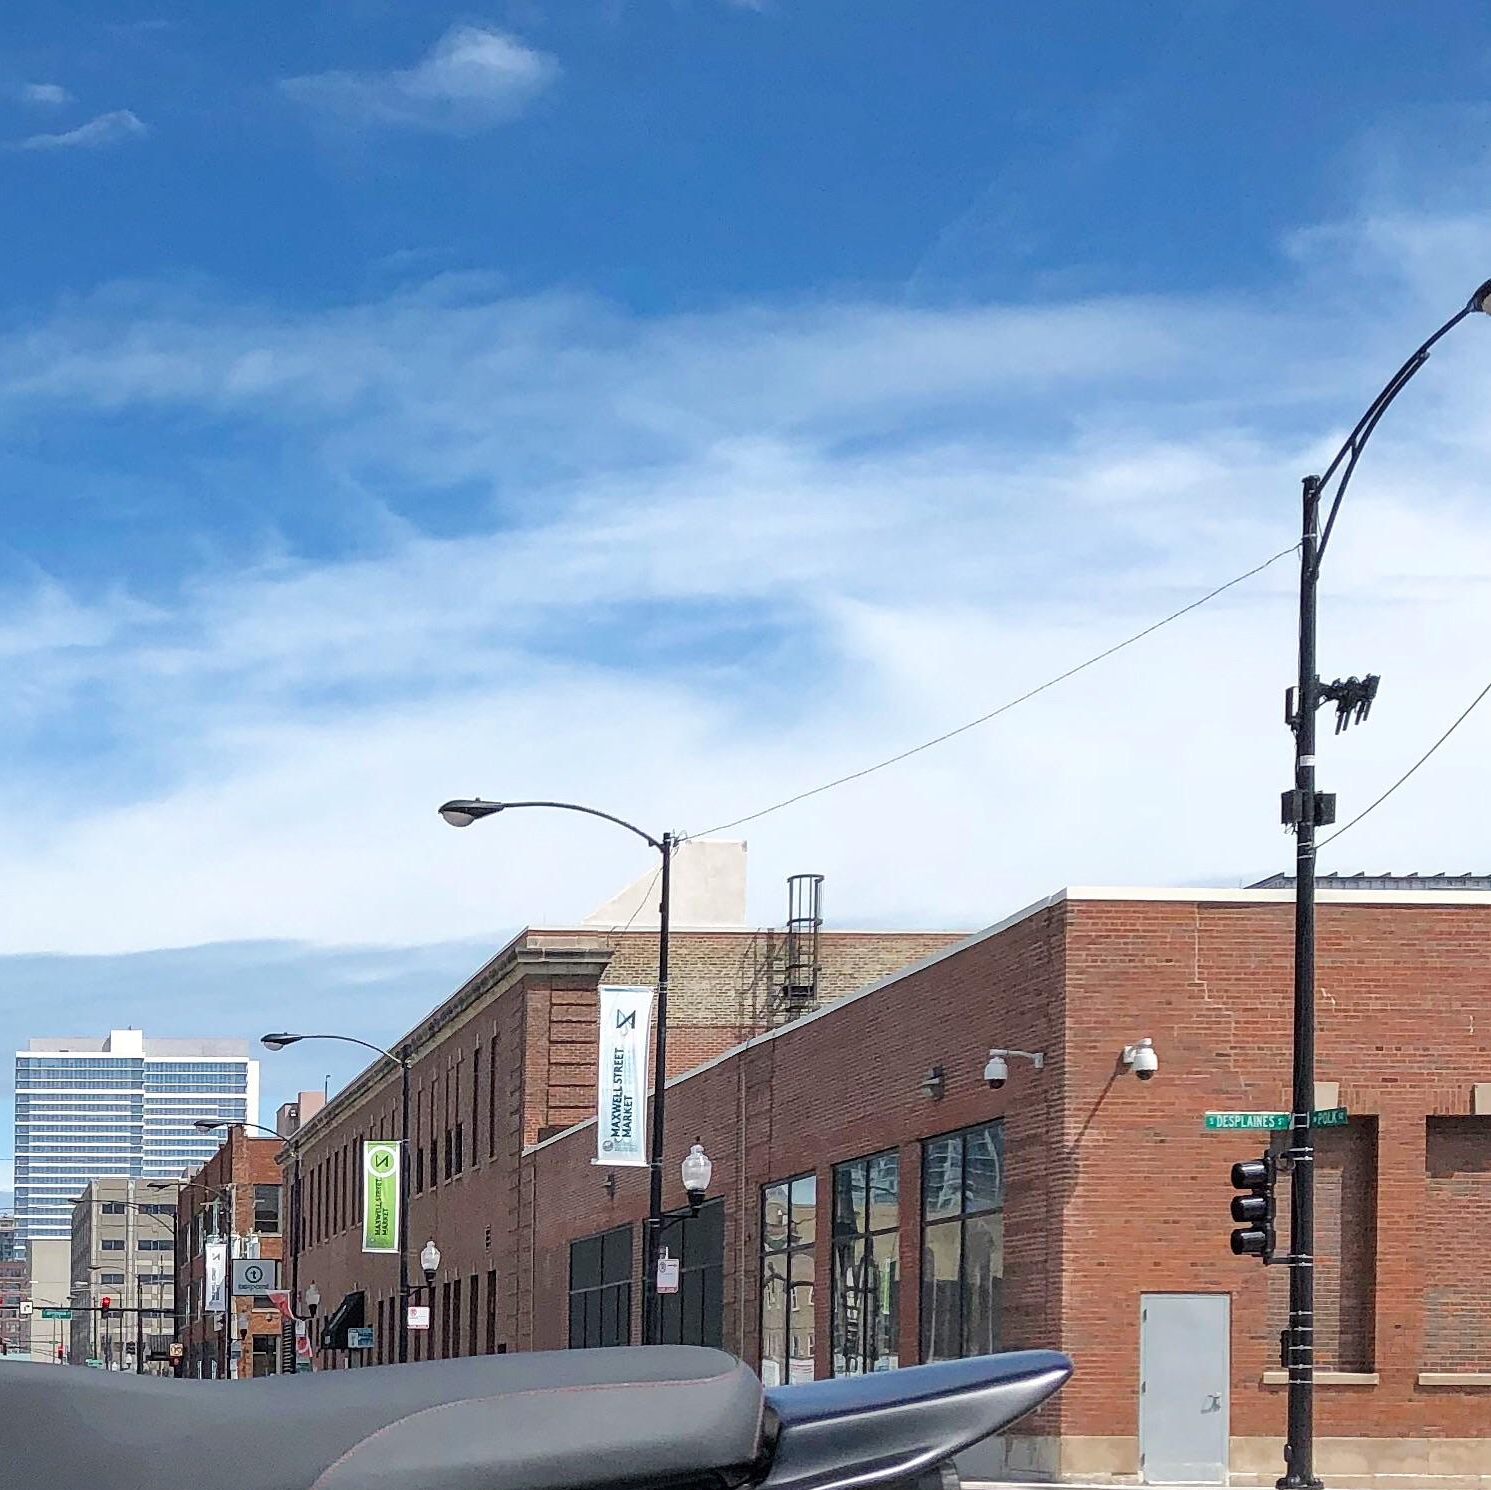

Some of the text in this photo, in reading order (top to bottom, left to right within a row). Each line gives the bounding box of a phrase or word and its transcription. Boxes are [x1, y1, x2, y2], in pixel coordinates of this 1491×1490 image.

[611, 1048, 625, 1138] MAXWELL STREET
[622, 1096, 633, 1138] MARKET
[1216, 1115, 1275, 1128] DESPLAINES
[1317, 1112, 1338, 1125] POLK
